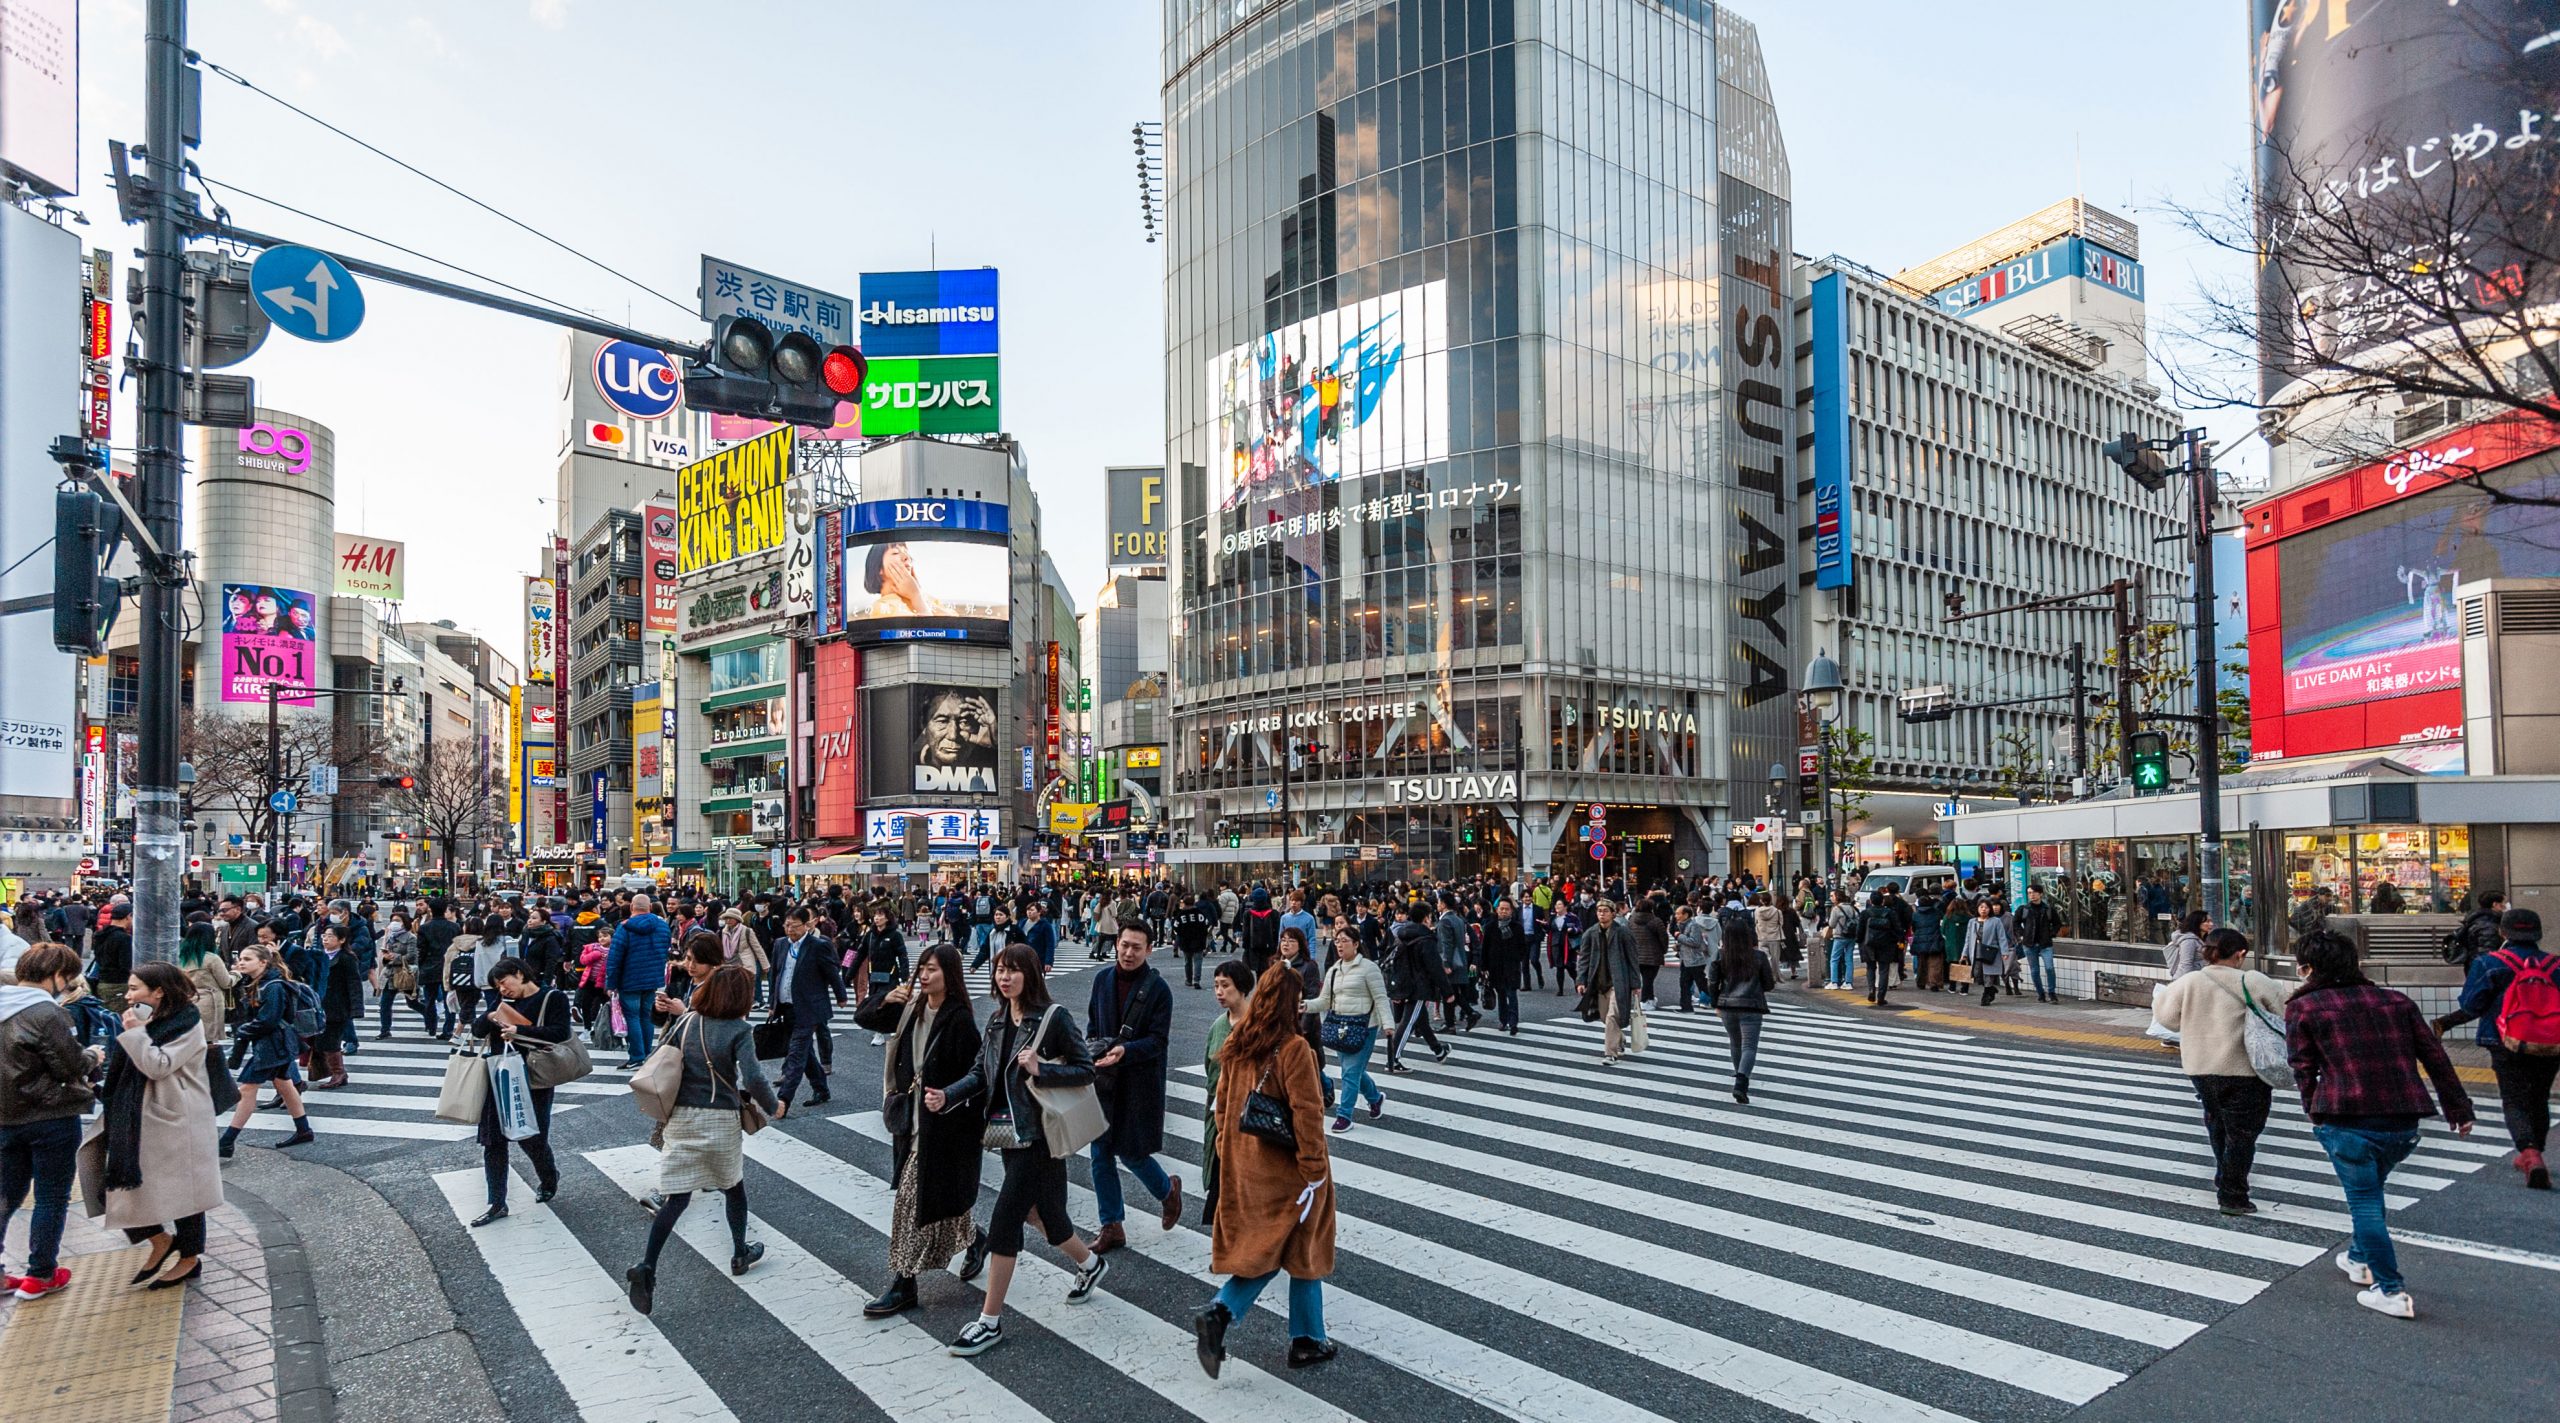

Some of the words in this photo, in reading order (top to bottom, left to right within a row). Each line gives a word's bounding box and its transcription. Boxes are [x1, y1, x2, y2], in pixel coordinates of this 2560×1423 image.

[1945, 252, 2052, 317] SEIBU
[2084, 248, 2140, 296] SEIBU
[715, 269, 842, 331] 渋谷駅前
[860, 300, 995, 325] Hisamitsu
[866, 380, 992, 409] サロンパス
[238, 423, 313, 475] 109
[238, 455, 285, 473] SHIBUYA
[652, 439, 688, 457] VISA
[679, 426, 793, 521] CEREMONY
[1735, 249, 1788, 709] TSUTAYA
[2384, 447, 2475, 494] Glico
[895, 502, 946, 522] DHC
[1142, 477, 1161, 525] F
[679, 504, 732, 574] KING
[735, 485, 785, 556] GNU
[787, 478, 814, 610] もんじゃ
[1816, 483, 1842, 573] SEIBU
[342, 543, 397, 577] H&M
[900, 630, 916, 638] DHC
[917, 629, 946, 638] Channel
[233, 645, 305, 681] No.1
[2295, 672, 2326, 690] LIVE
[2329, 666, 2362, 684] DAM
[714, 724, 765, 742] Euphoria
[1229, 709, 1330, 736] STARBUCKS
[1341, 702, 1417, 723] COFFEE
[1598, 706, 1697, 734] TSUTAYA
[819, 716, 852, 785] クスリ
[1803, 757, 1816, 771] 本
[1389, 775, 1518, 802] TSUTAYA
[873, 815, 990, 839] 大盛書店
